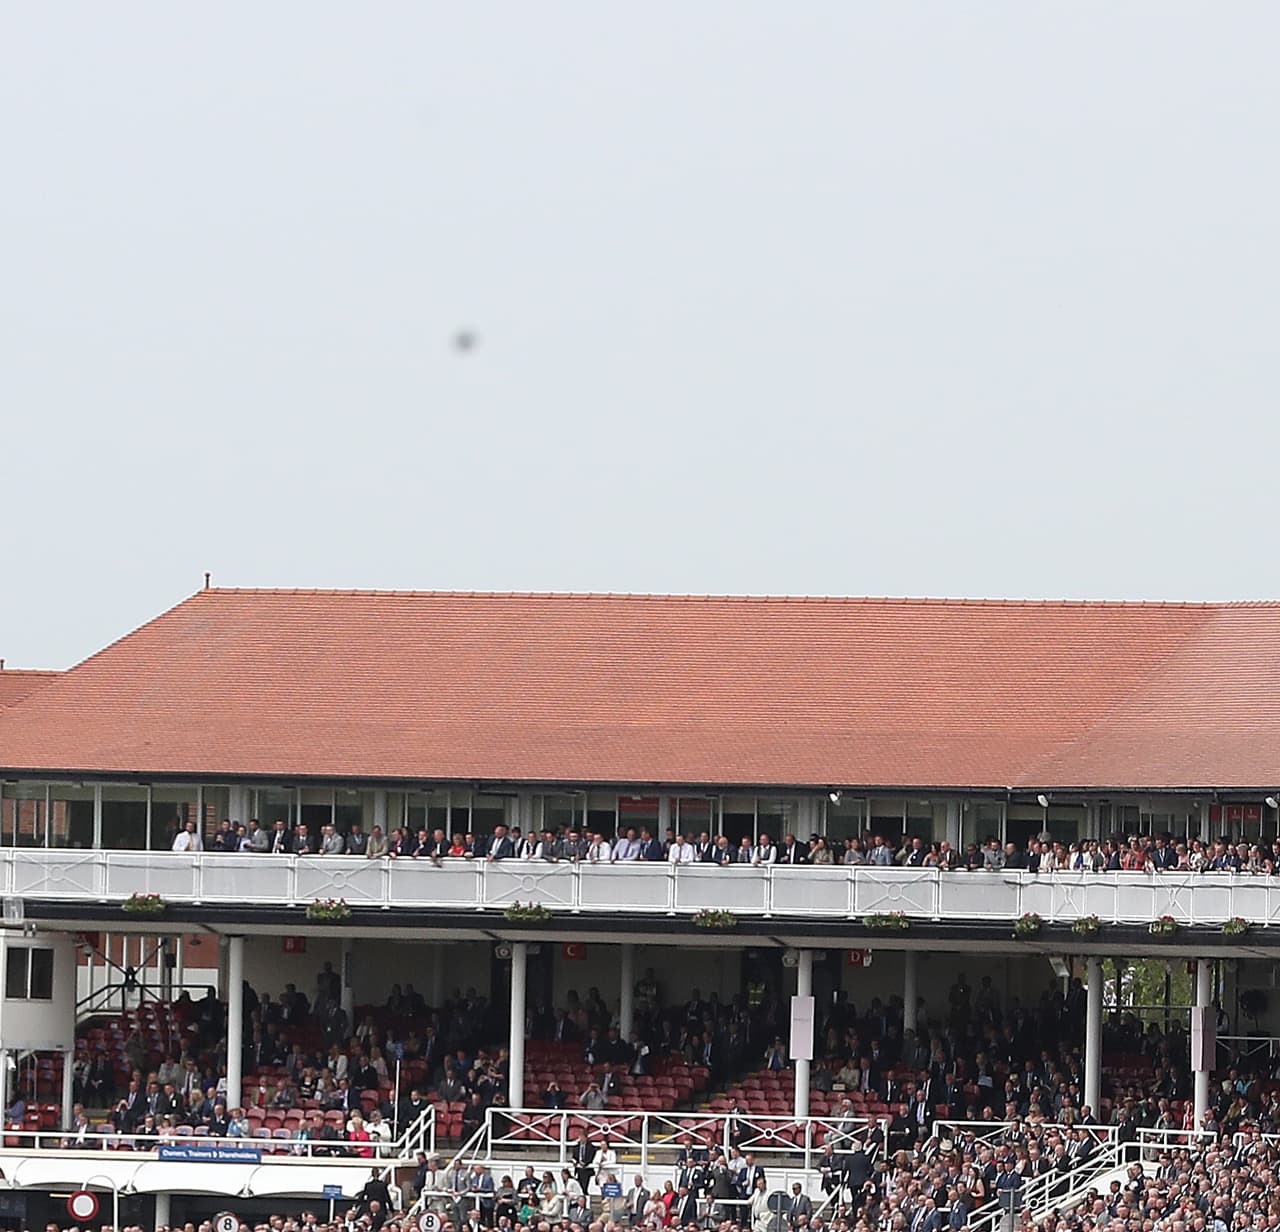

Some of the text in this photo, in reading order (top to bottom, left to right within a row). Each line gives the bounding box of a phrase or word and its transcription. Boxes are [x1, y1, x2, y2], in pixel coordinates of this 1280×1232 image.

[568, 945, 576, 956] C
[851, 951, 860, 962] D
[223, 1218, 232, 1230] 8
[426, 1215, 435, 1228] 8
